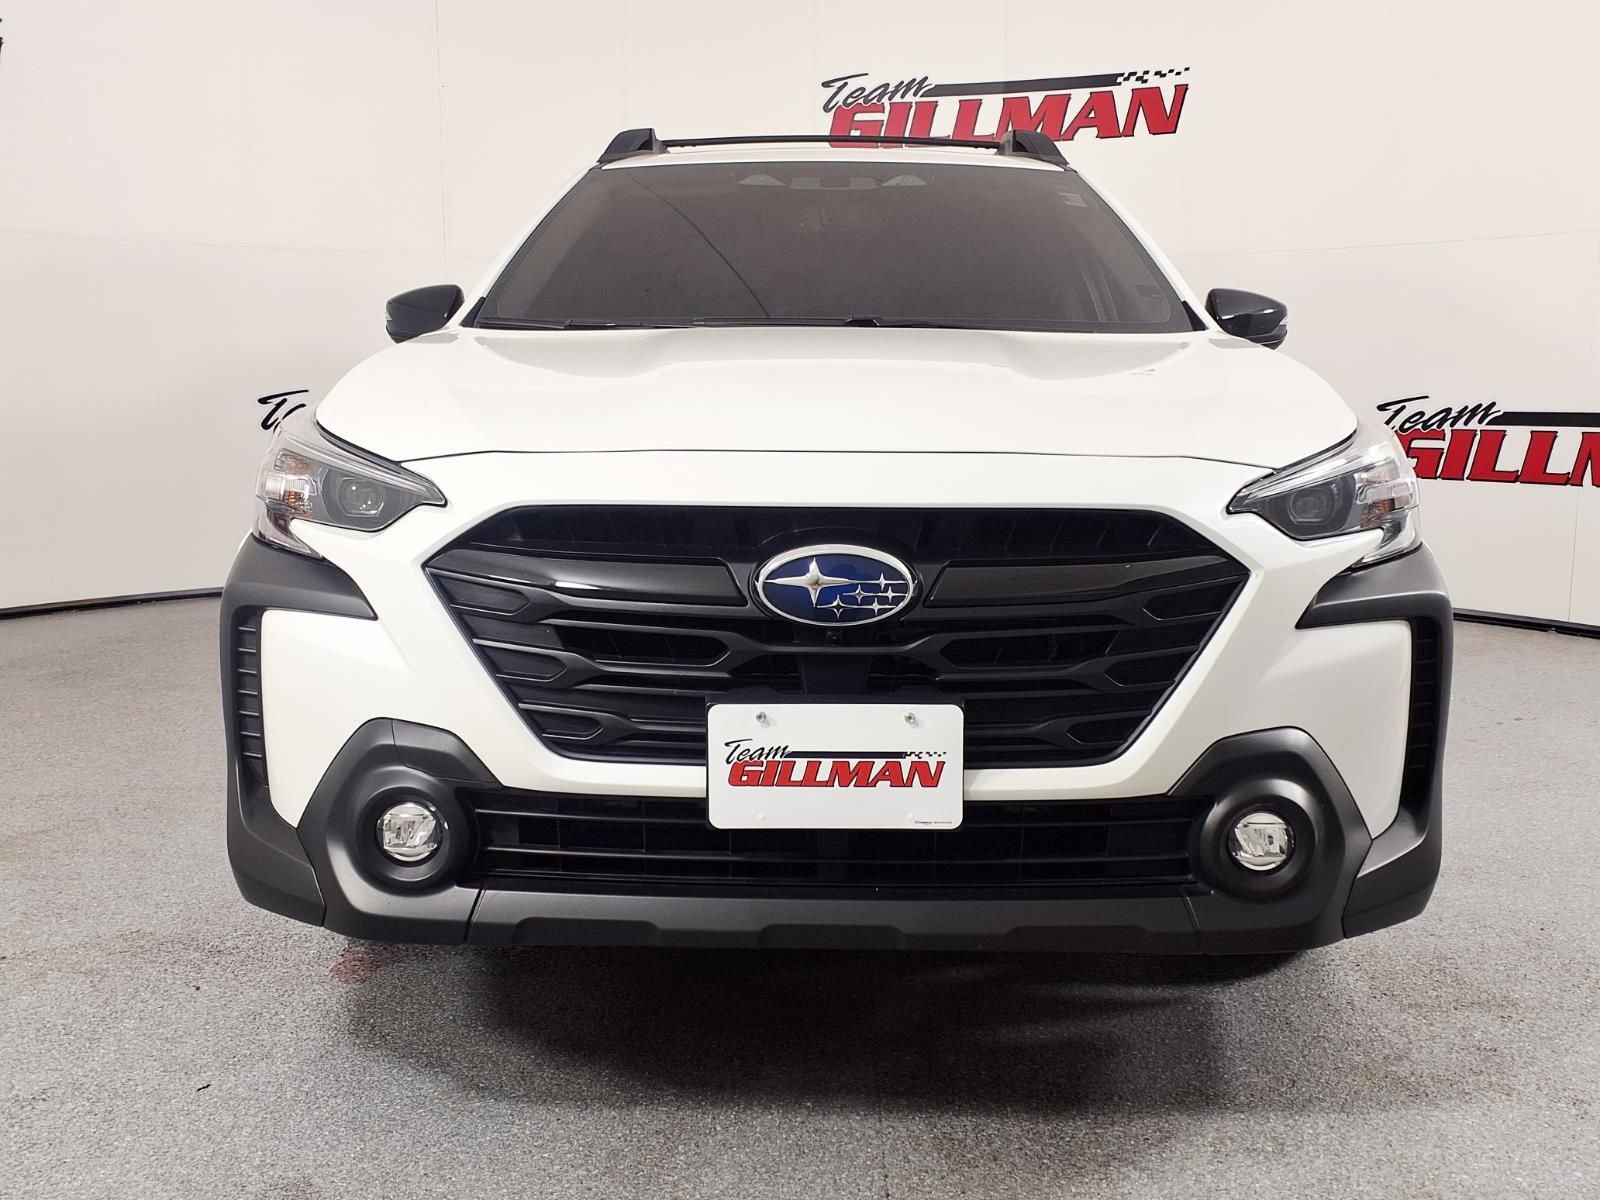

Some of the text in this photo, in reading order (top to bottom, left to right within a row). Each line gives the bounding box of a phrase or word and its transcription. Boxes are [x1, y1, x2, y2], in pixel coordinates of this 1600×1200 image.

[821, 73, 936, 113] Team
[828, 83, 1189, 148] GILLMAN
[1376, 395, 1501, 434] Team
[724, 738, 792, 765] Team
[728, 760, 946, 788] GILLMAN
